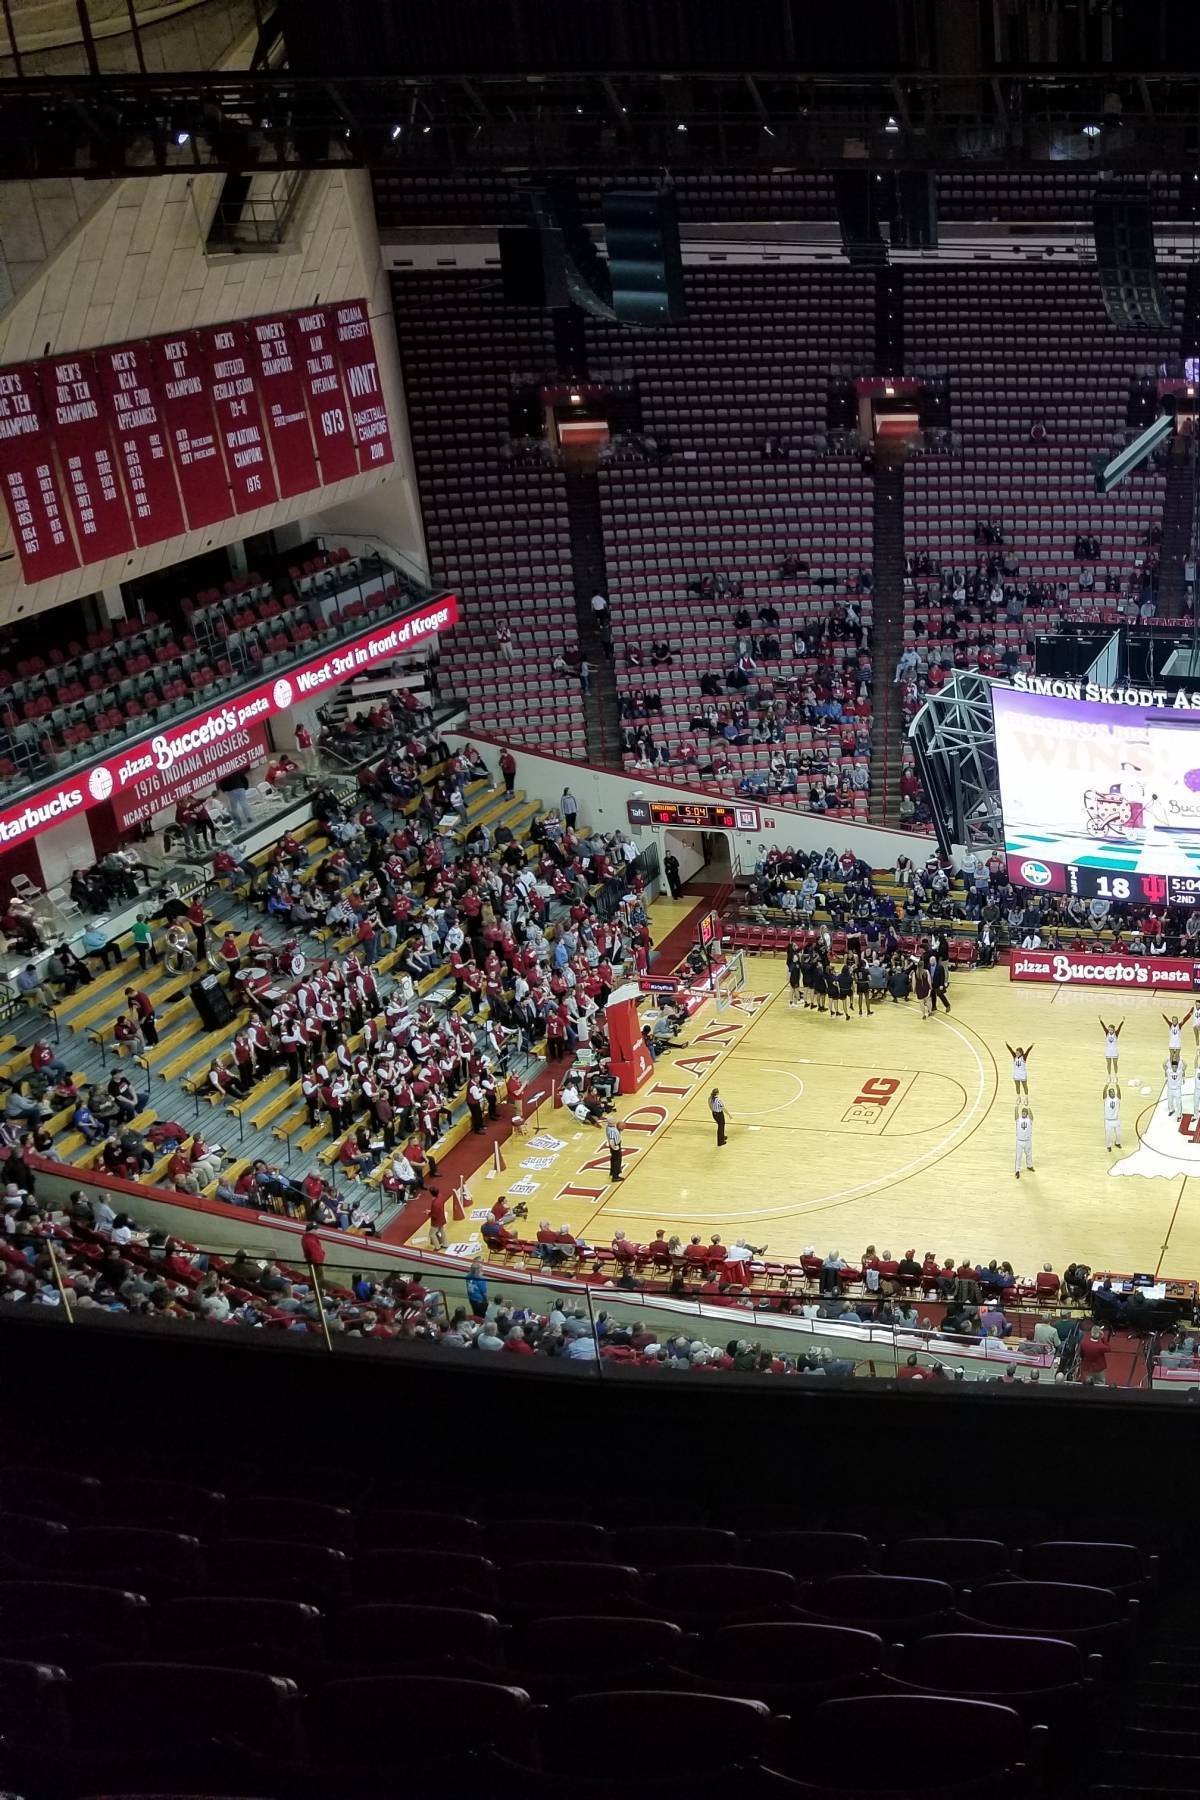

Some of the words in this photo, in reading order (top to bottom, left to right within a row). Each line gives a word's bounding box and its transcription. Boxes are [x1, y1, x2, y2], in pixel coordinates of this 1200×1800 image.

[298, 312, 326, 333] WOMEN'S
[338, 306, 363, 324] INDIANA
[214, 332, 235, 350] MEN'S
[255, 322, 286, 342] WOMEN'S
[338, 322, 370, 342] UNIVERSITY
[164, 340, 188, 360] MEN'S
[274, 340, 288, 356] TEN
[56, 362, 82, 383] MEN'S
[111, 352, 136, 372] MEN'S
[262, 356, 294, 376] CHAMPIONS
[166, 376, 202, 400] CHAMPIONS
[347, 362, 378, 398] WNIT
[72, 382, 91, 400] TEN
[0, 397, 10, 417] IG
[11, 394, 31, 414] TEN
[56, 400, 98, 424] CHAMPIONS
[354, 406, 386, 426] BASKETBALL
[322, 408, 345, 436] 1973
[358, 420, 388, 442] CHAMPIONS
[246, 474, 262, 494] 1975
[296, 663, 331, 693] West
[332, 650, 354, 674] 3rd
[355, 647, 369, 664] in
[368, 630, 398, 658] front
[398, 623, 411, 642] of
[411, 607, 448, 636] Kroger
[1014, 671, 1082, 700] SIMON
[1086, 682, 1168, 708] SKJODT
[118, 754, 154, 785] pizza
[152, 708, 238, 770] Bucceto's
[238, 697, 270, 725] pasta
[134, 774, 160, 800] 1976
[162, 752, 203, 786] INDIANA
[202, 728, 250, 764] HOOSIERS
[122, 804, 150, 827] NCAA'S
[150, 800, 160, 813] #1
[161, 781, 193, 808] ALL-TIME
[192, 772, 217, 794] MARCH
[216, 755, 248, 778] MADNESS
[248, 744, 266, 762] TEAM
[0, 788, 82, 842] tarbucks
[631, 808, 646, 818] Taft
[660, 812, 670, 822] 18
[684, 806, 706, 816] 5:04
[724, 816, 732, 826] 18
[1096, 876, 1130, 898] 18
[1014, 959, 1050, 974] pizza
[1052, 955, 1150, 983] Bucceto's
[1152, 970, 1190, 984] pasta
[553, 992, 772, 1204] INDIANA
